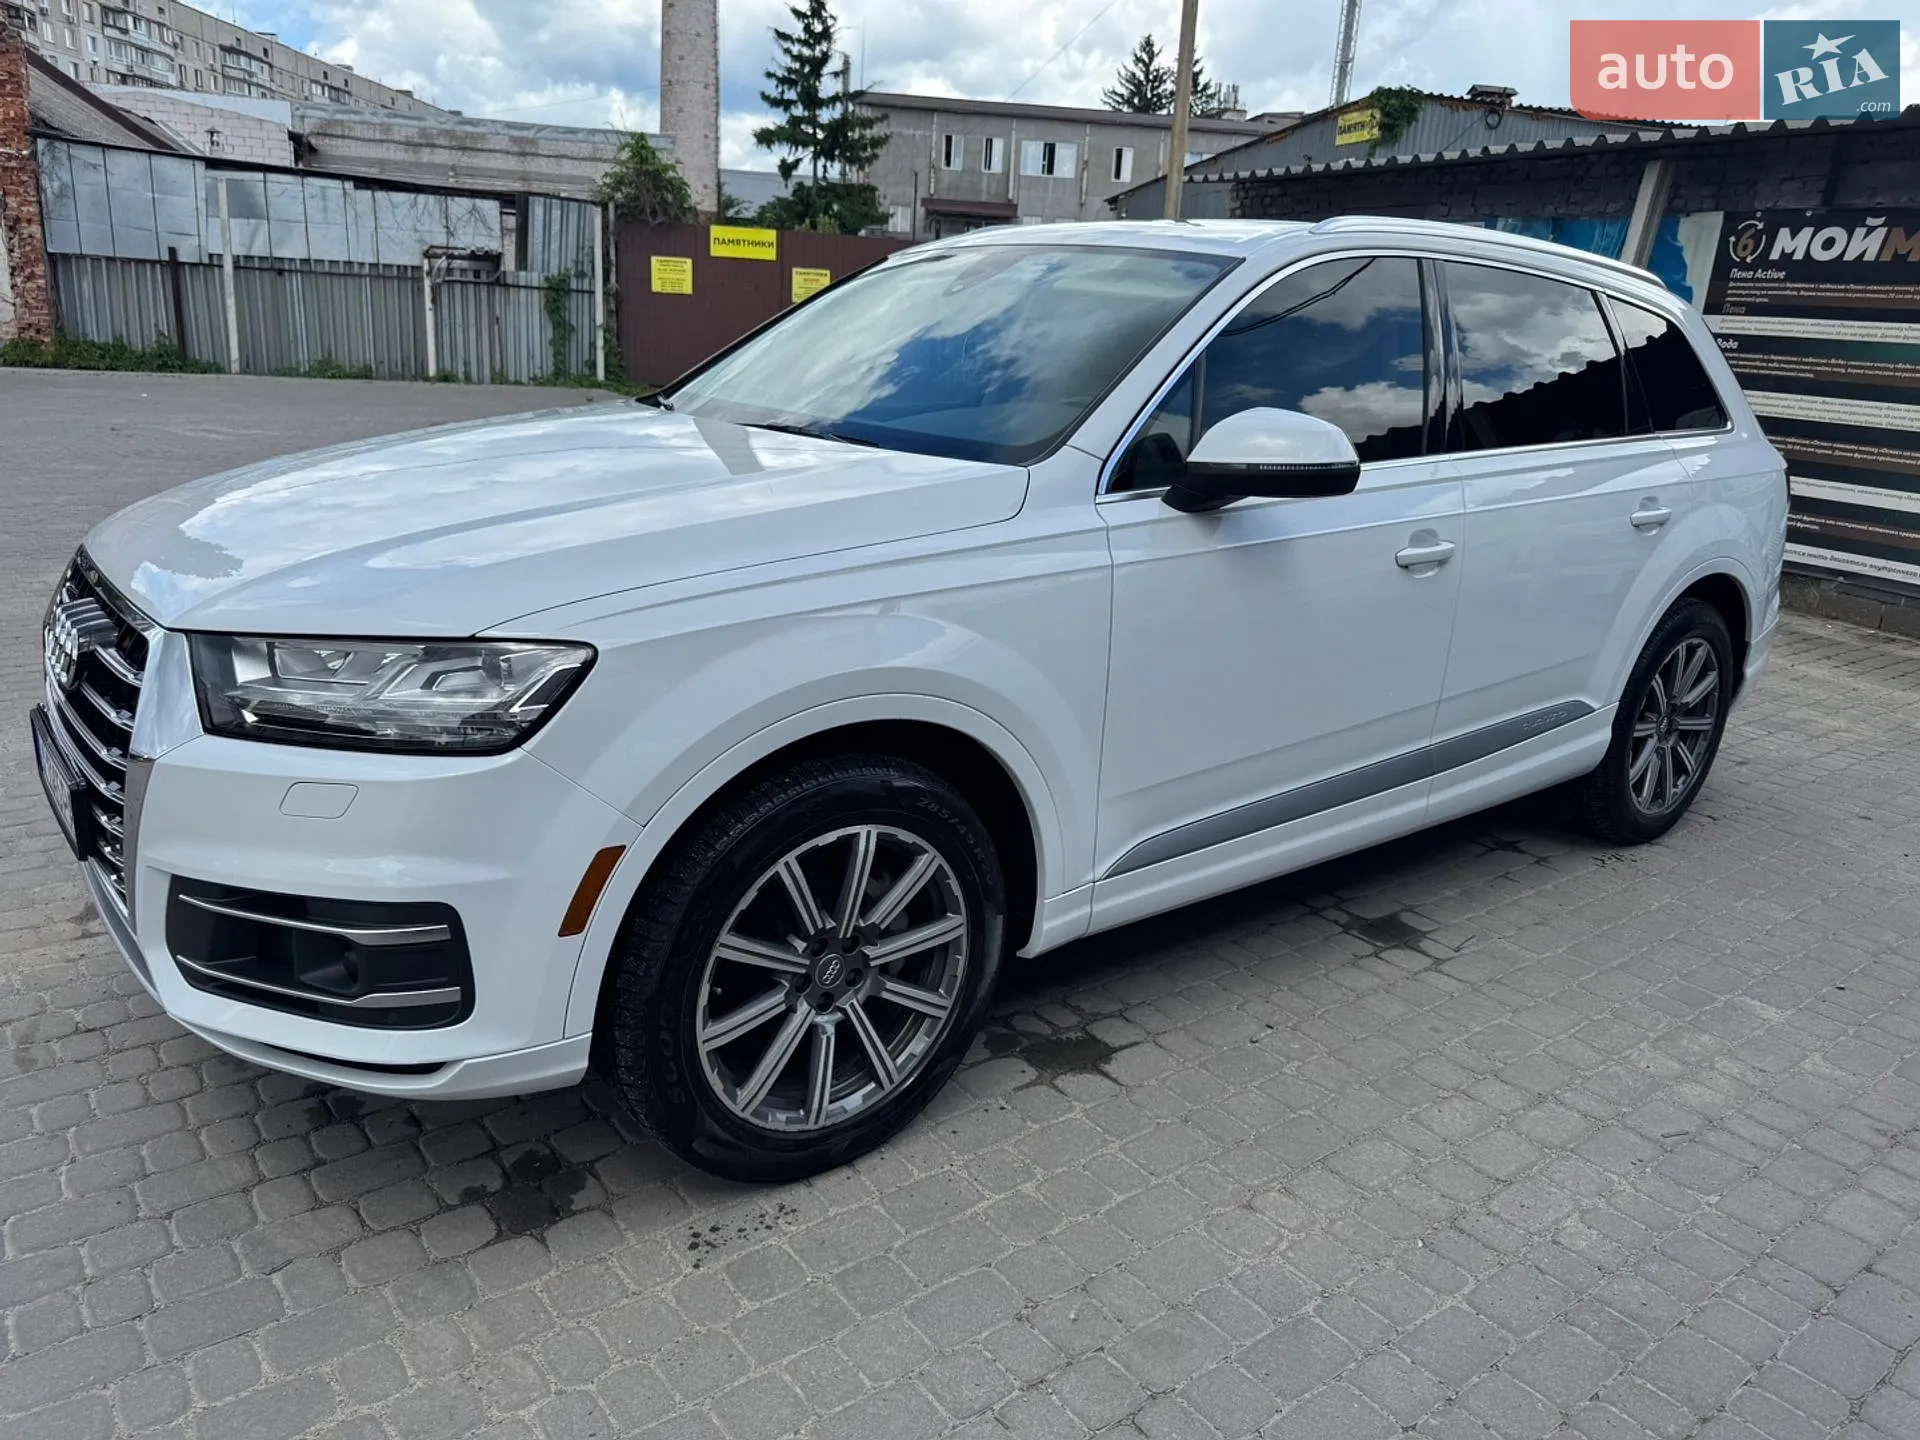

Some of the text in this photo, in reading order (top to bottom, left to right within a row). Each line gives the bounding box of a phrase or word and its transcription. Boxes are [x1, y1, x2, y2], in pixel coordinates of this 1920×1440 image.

[713, 237, 774, 249] ПАМЯТНИКИ
[1729, 267, 1786, 280] Пена Active
[1722, 303, 1746, 314] Пена
